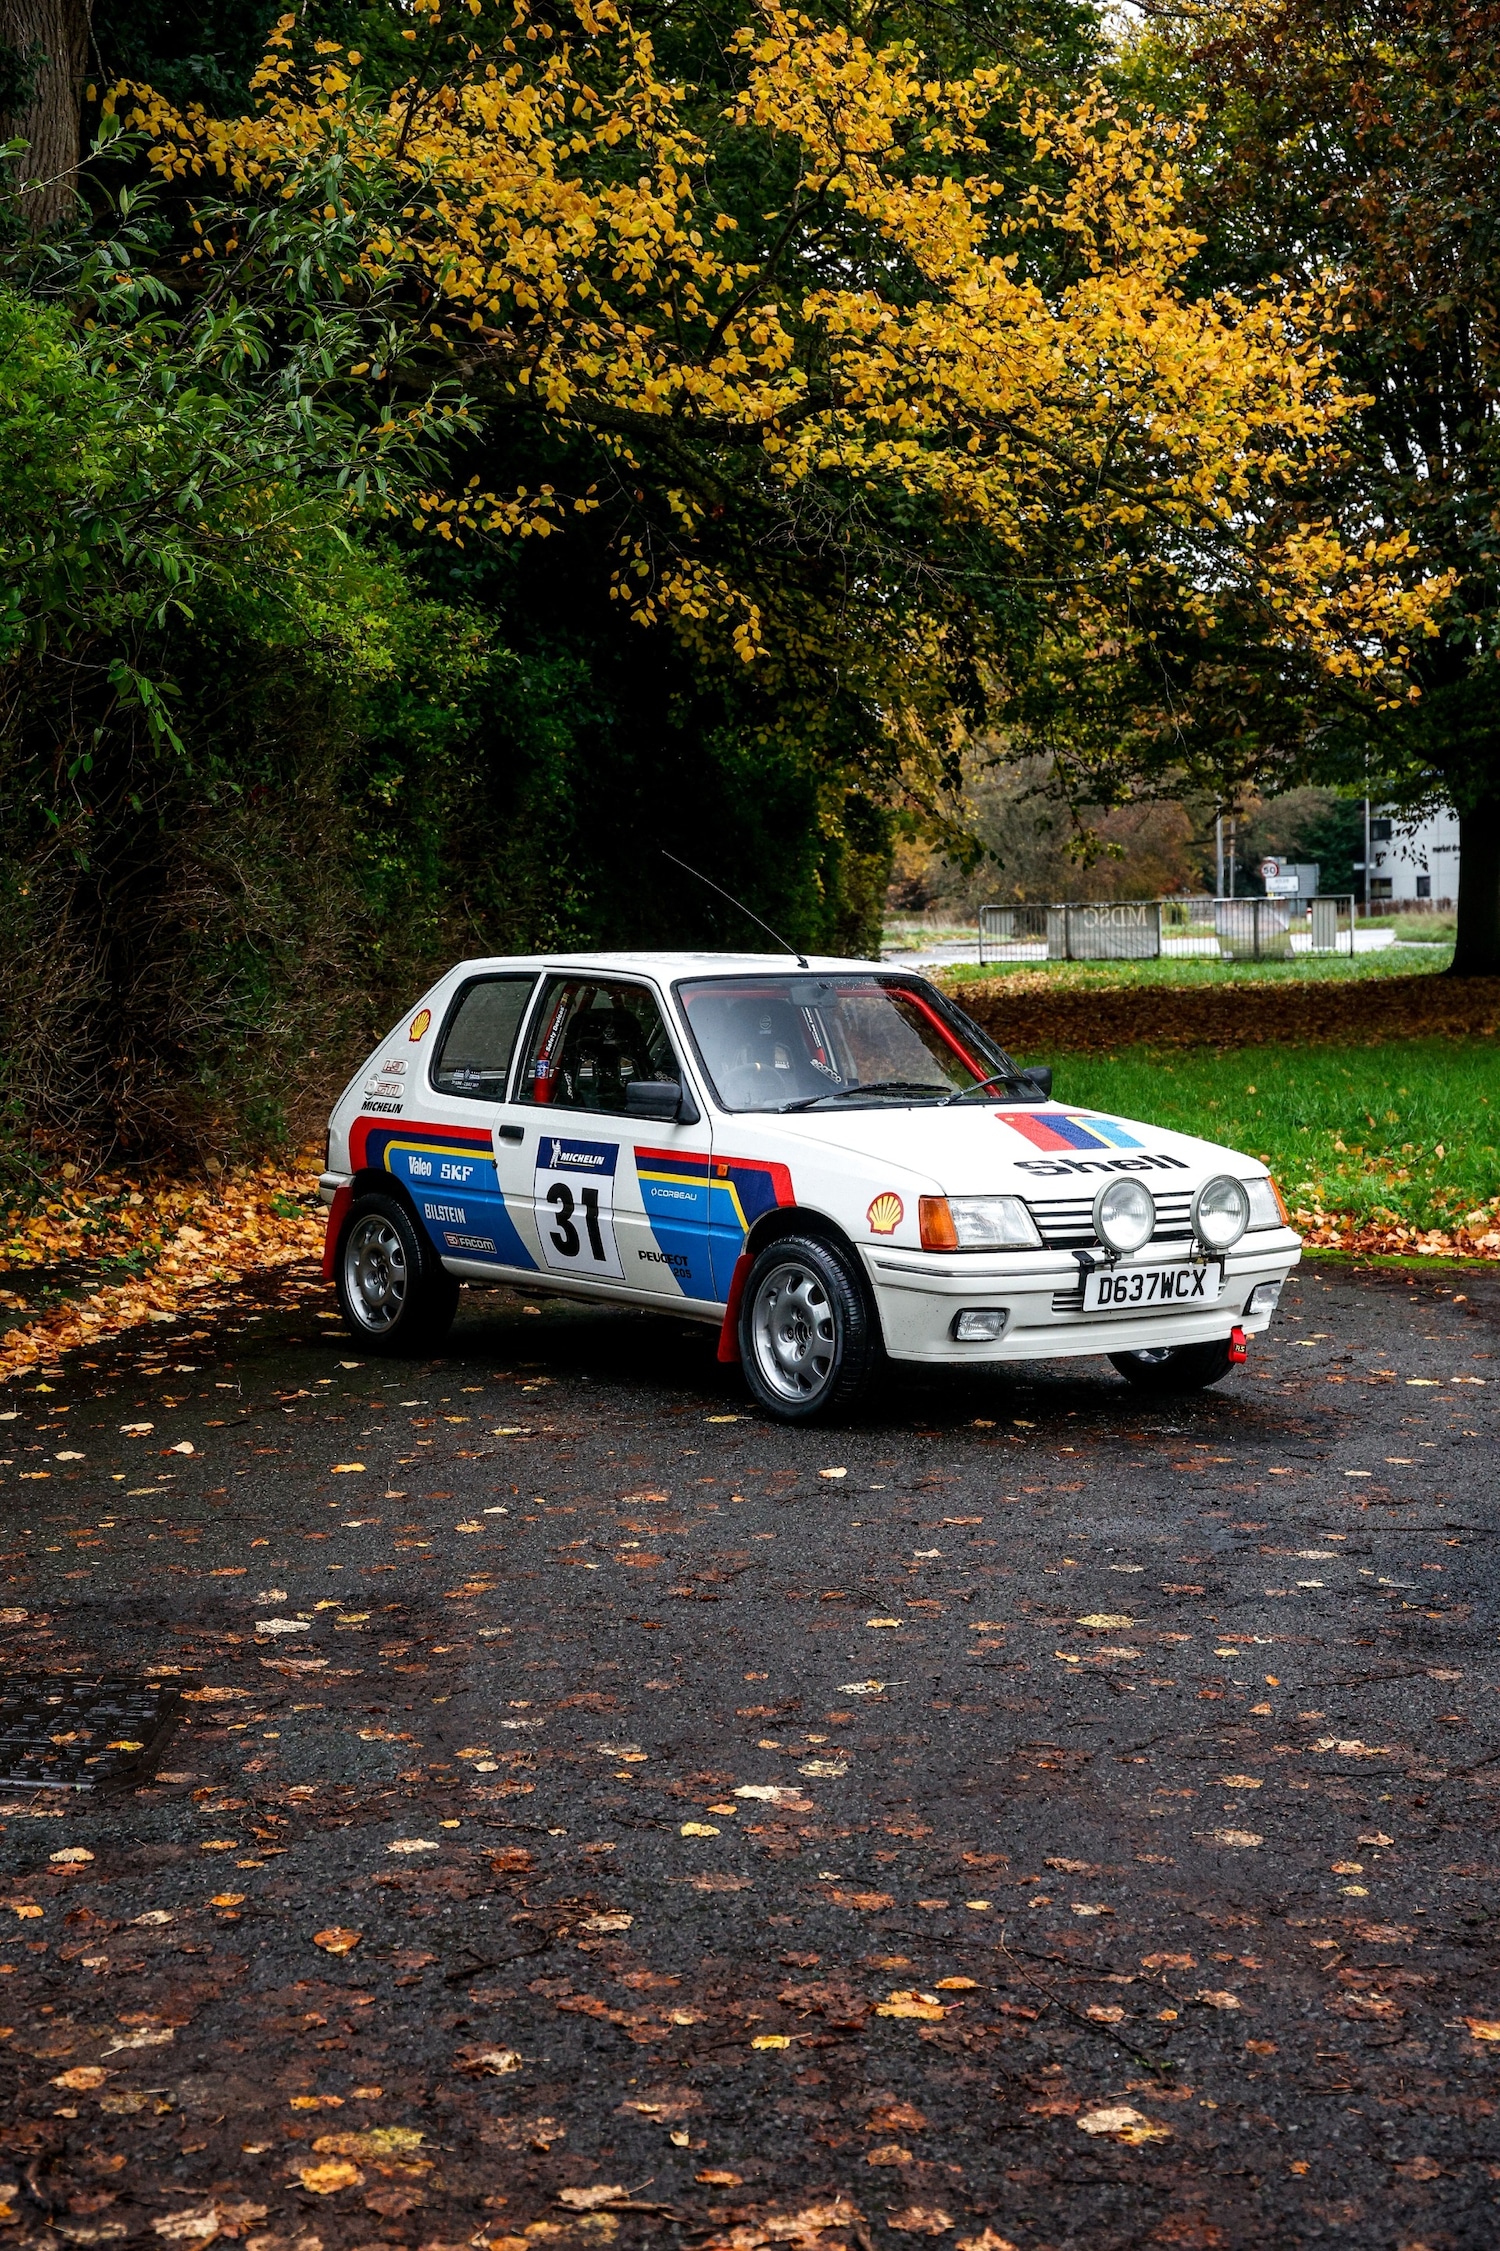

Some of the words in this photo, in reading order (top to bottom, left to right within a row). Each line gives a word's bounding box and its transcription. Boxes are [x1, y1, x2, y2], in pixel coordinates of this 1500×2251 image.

[1263, 866, 1275, 874] 50
[545, 1031, 556, 1052] Safety
[553, 1005, 565, 1031] Devices
[810, 1058, 842, 1083] sparco
[361, 1101, 404, 1114] MICHELIN
[408, 1155, 432, 1177] Valeo
[560, 1152, 605, 1165] MICHELIN
[1013, 1155, 1191, 1176] Shell
[440, 1163, 474, 1182] SKF
[657, 1189, 698, 1201] CORBEAU
[424, 1203, 467, 1224] BILSTEIN
[546, 1182, 607, 1262] 31
[459, 1237, 495, 1251] FACOM
[638, 1250, 688, 1266] PEUGEOT
[673, 1267, 692, 1279] 205
